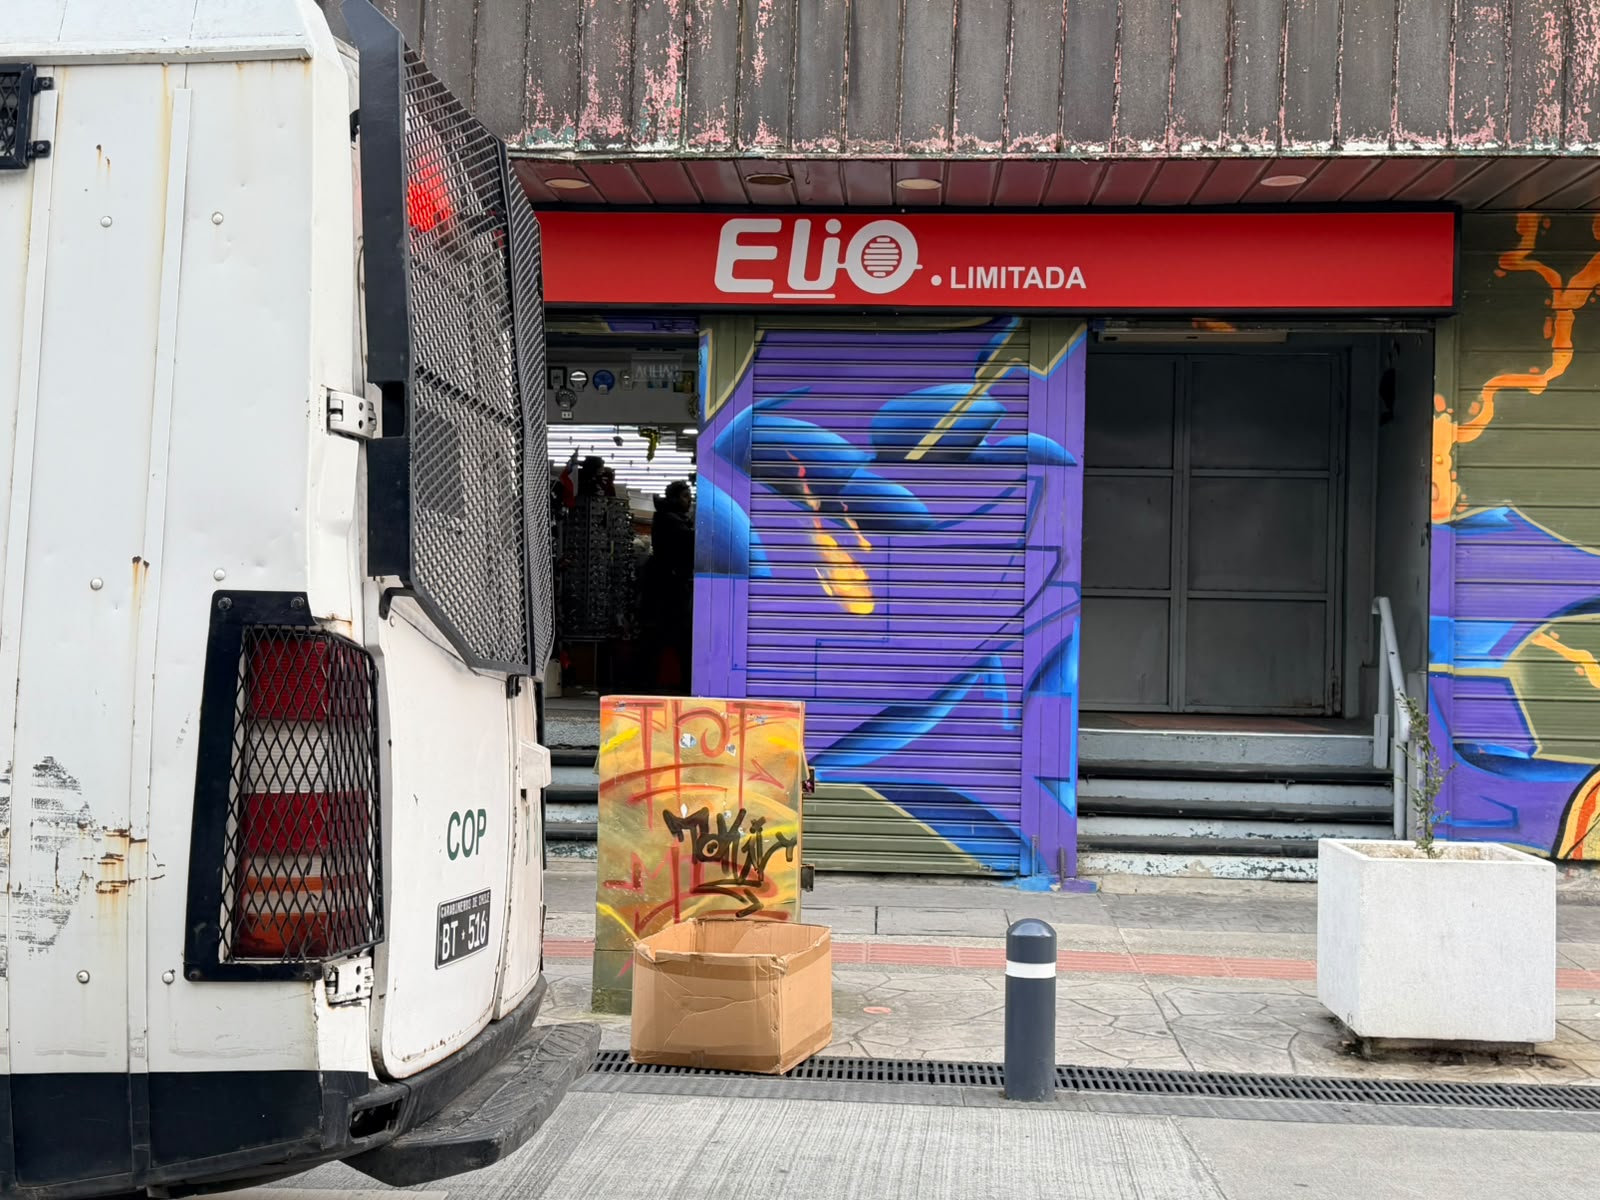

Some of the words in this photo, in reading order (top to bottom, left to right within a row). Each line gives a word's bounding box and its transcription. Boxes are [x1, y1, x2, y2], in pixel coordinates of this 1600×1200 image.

[950, 266, 1087, 290] LIMITADA
[446, 808, 487, 861] COP
[442, 920, 459, 961] BT
[467, 910, 486, 950] 516
